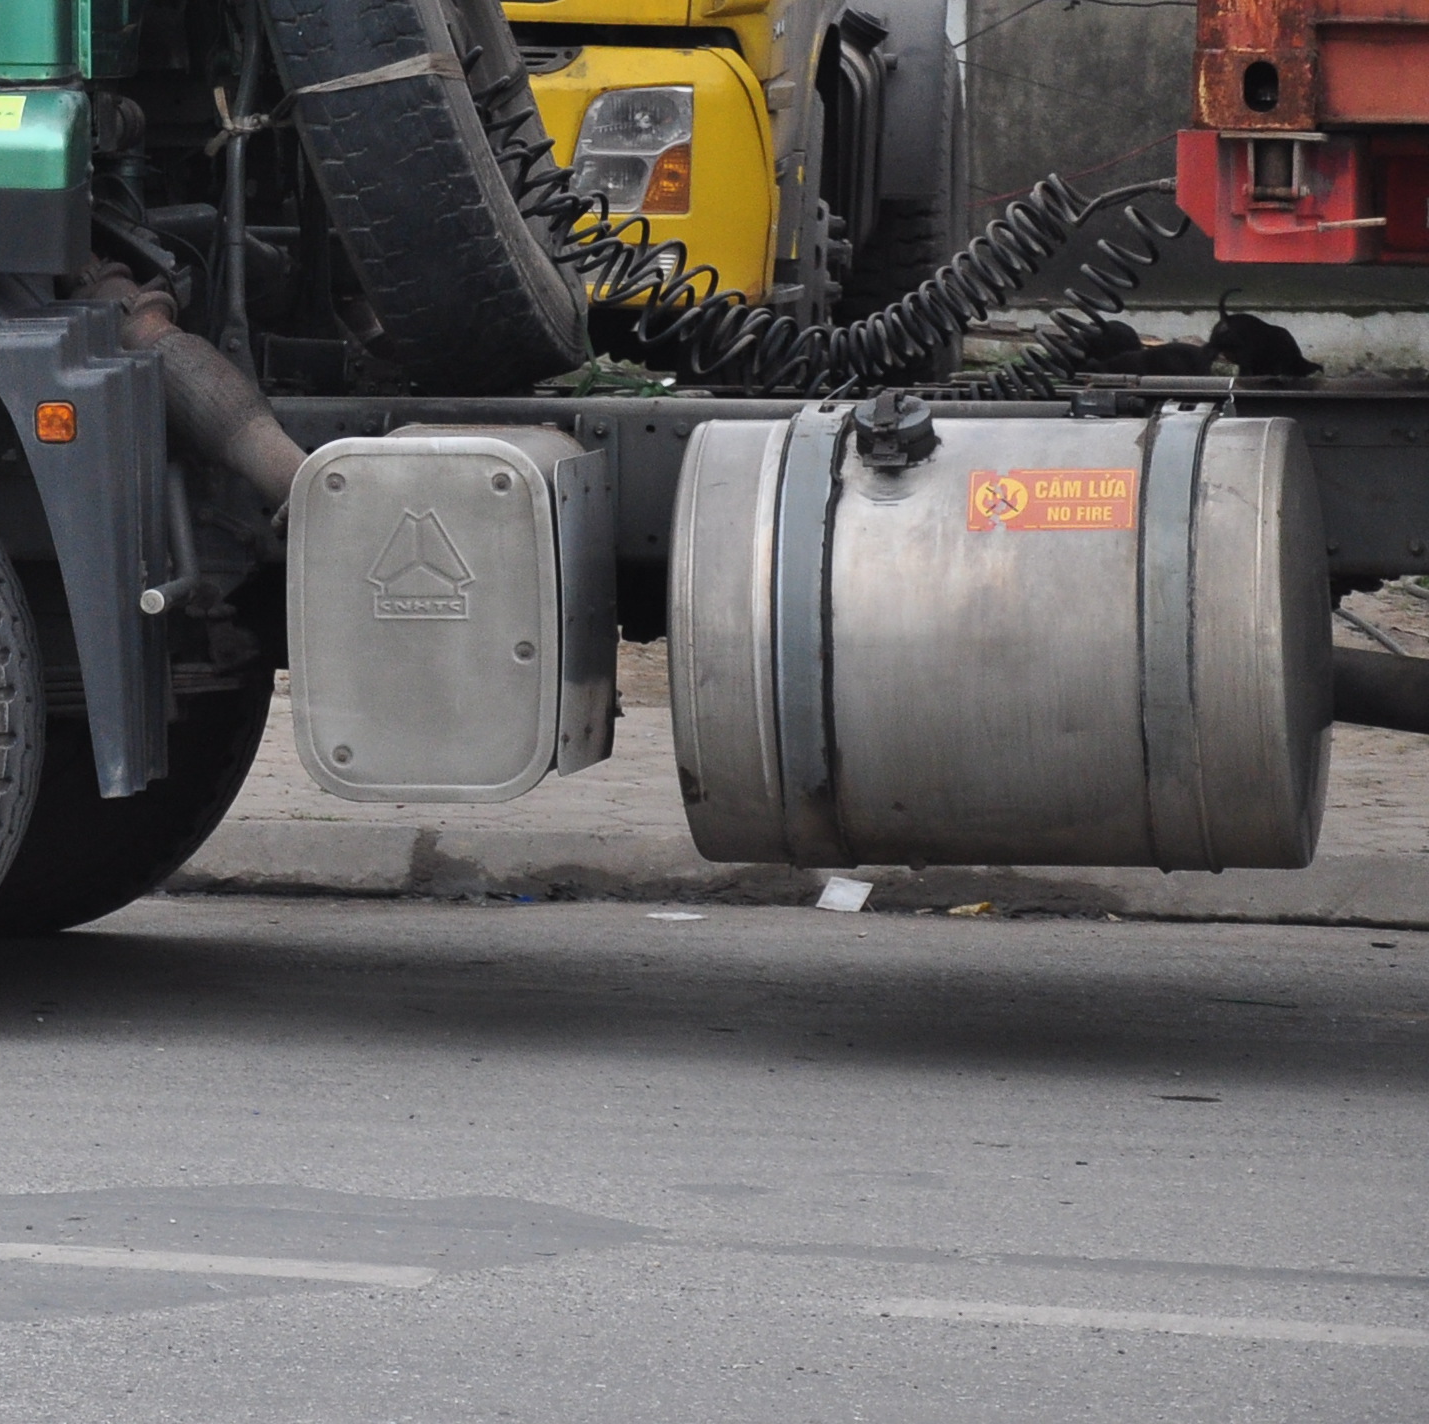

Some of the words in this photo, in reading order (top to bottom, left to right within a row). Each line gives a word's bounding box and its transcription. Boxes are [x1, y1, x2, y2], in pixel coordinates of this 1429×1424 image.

[1034, 474, 1082, 498] CẤM
[1088, 473, 1127, 498] LỬA
[1047, 506, 1071, 522] NO
[1076, 506, 1113, 521] FIRE
[379, 600, 462, 613] CNHTC
